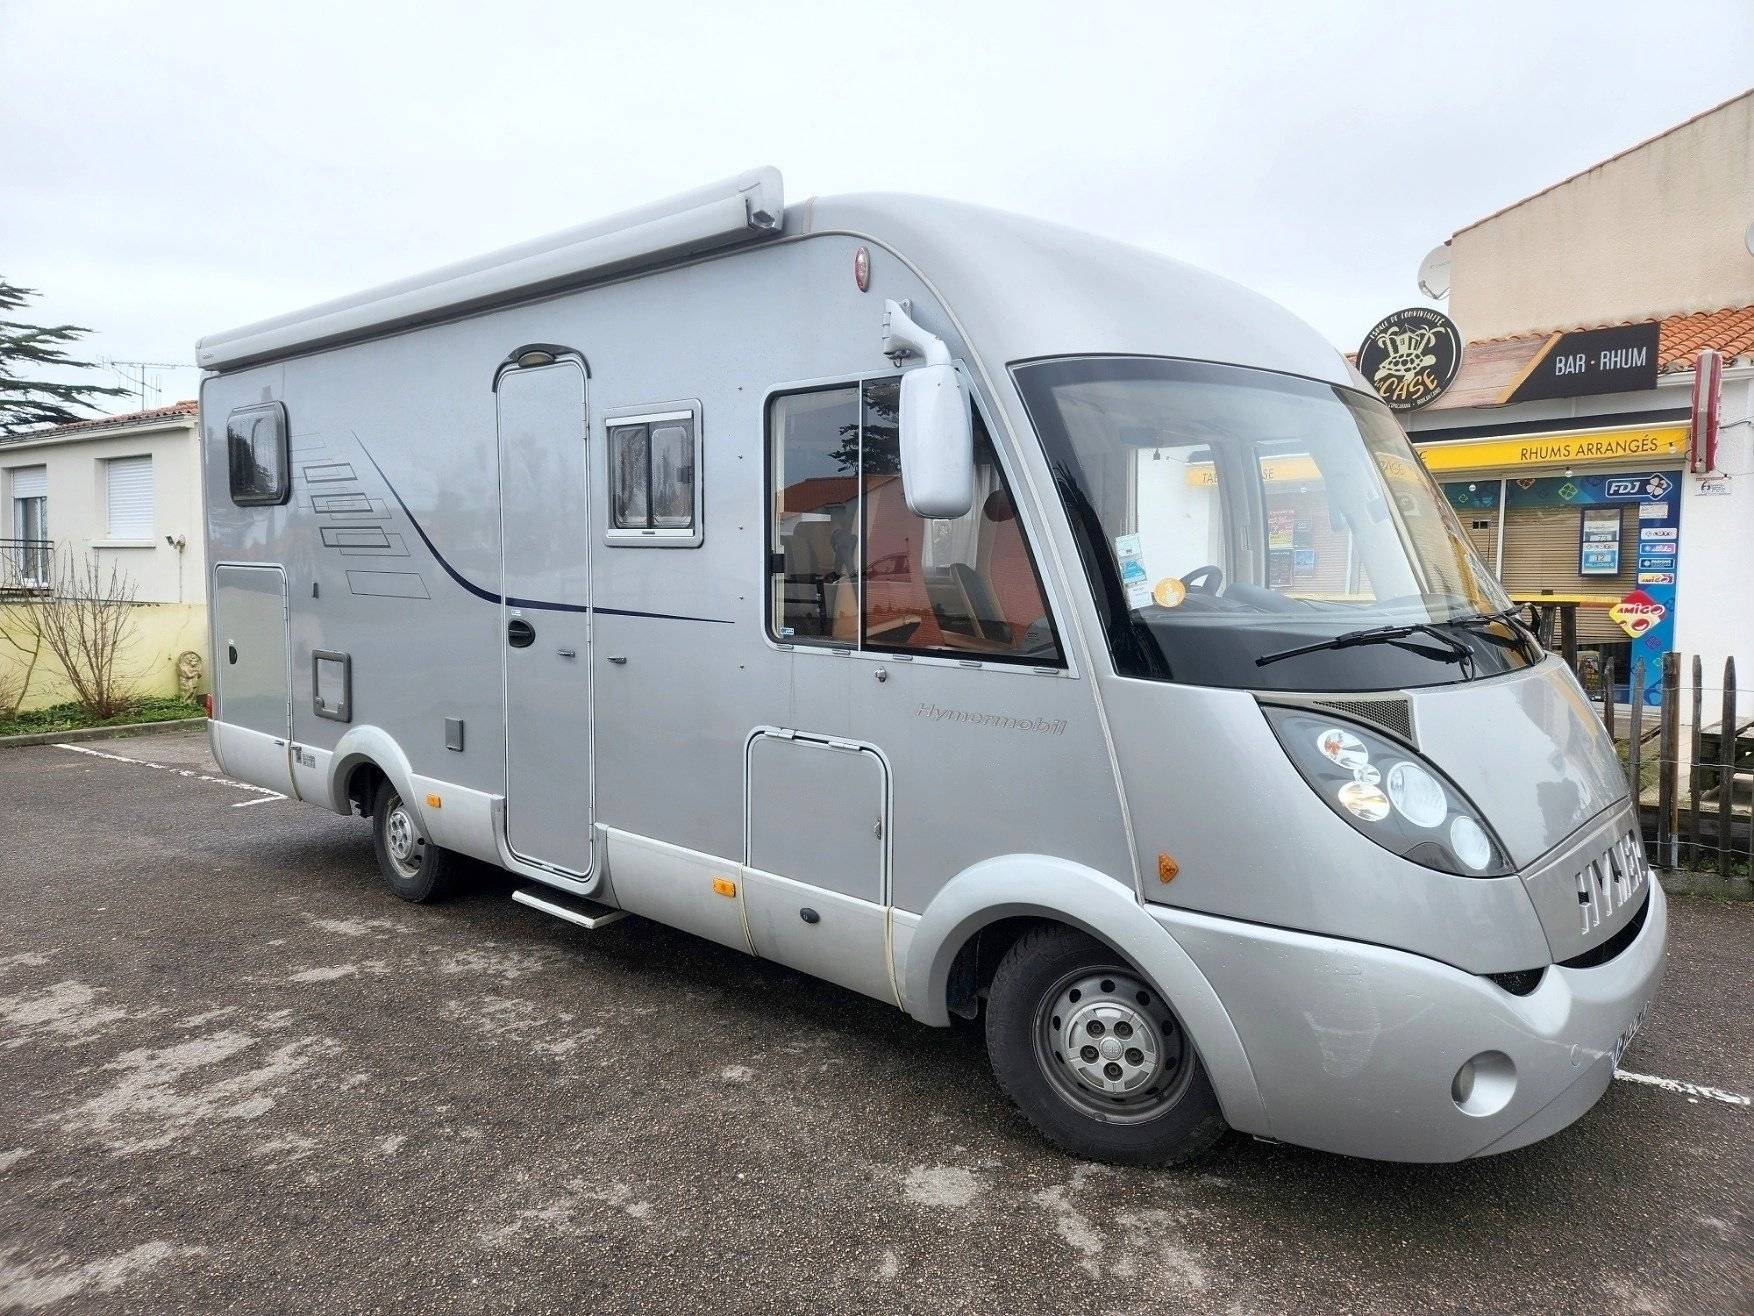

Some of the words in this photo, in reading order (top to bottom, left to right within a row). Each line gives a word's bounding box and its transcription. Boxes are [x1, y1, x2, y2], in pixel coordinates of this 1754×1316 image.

[1555, 353, 1586, 376] BAR
[1599, 346, 1647, 371] RHUM
[1380, 368, 1438, 400] CASE
[1520, 444, 1571, 461] RHUMS
[1575, 434, 1659, 457] ARRANGÉS
[1609, 481, 1641, 494] FDJ
[916, 702, 1069, 736] Hymermobil
